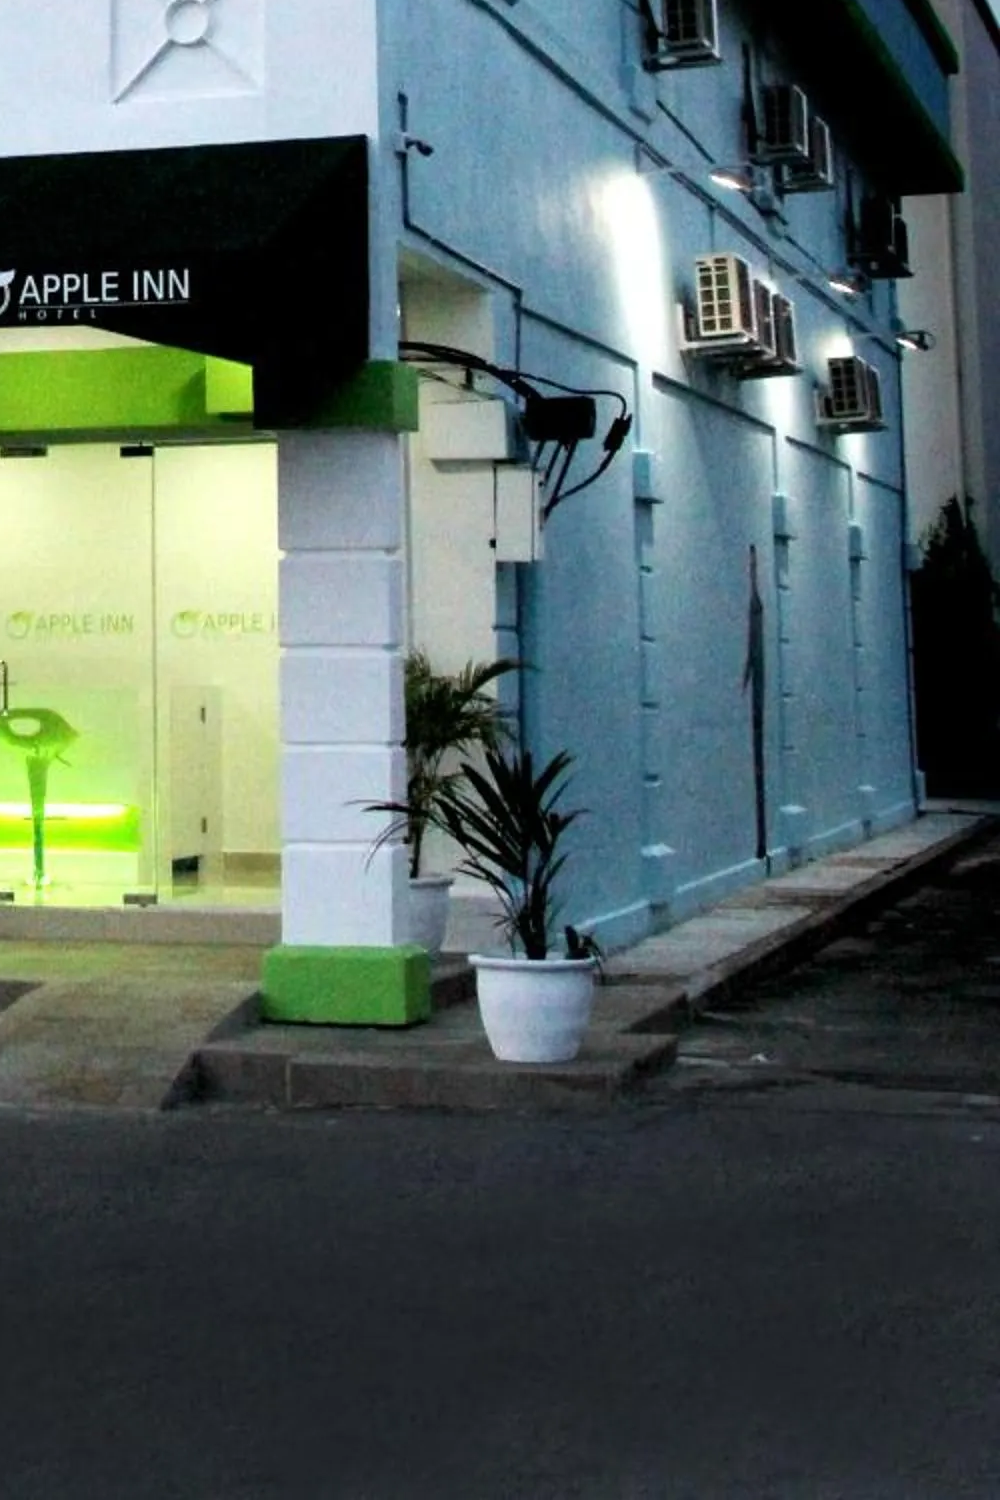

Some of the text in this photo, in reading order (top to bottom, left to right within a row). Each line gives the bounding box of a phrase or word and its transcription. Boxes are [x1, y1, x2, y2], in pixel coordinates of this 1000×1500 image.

[19, 268, 189, 304] APPLE INN
[18, 308, 97, 320] HOTEL
[34, 611, 135, 635] APPLE INN
[202, 611, 264, 634] APPLE
